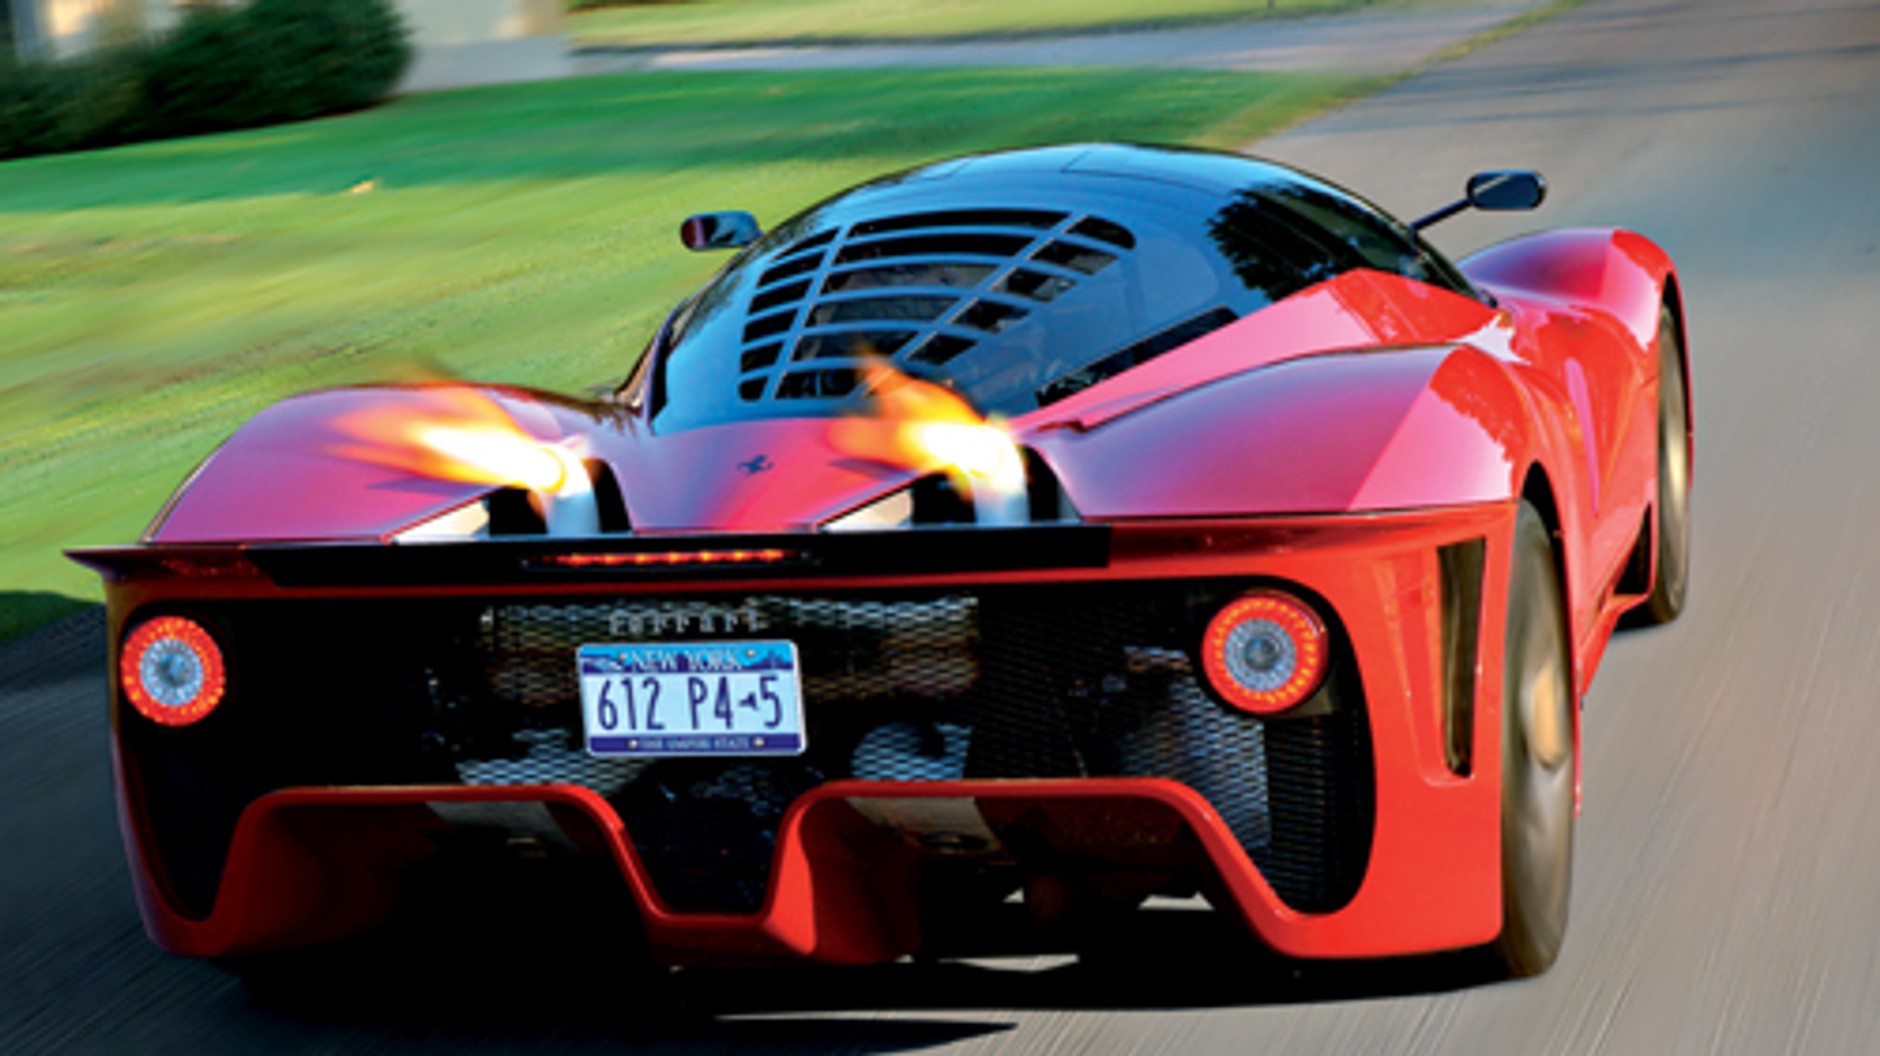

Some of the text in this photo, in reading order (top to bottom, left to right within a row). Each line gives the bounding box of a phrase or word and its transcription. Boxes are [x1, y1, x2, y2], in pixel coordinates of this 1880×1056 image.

[631, 649, 743, 671] NEW YORK
[598, 675, 665, 731] 612
